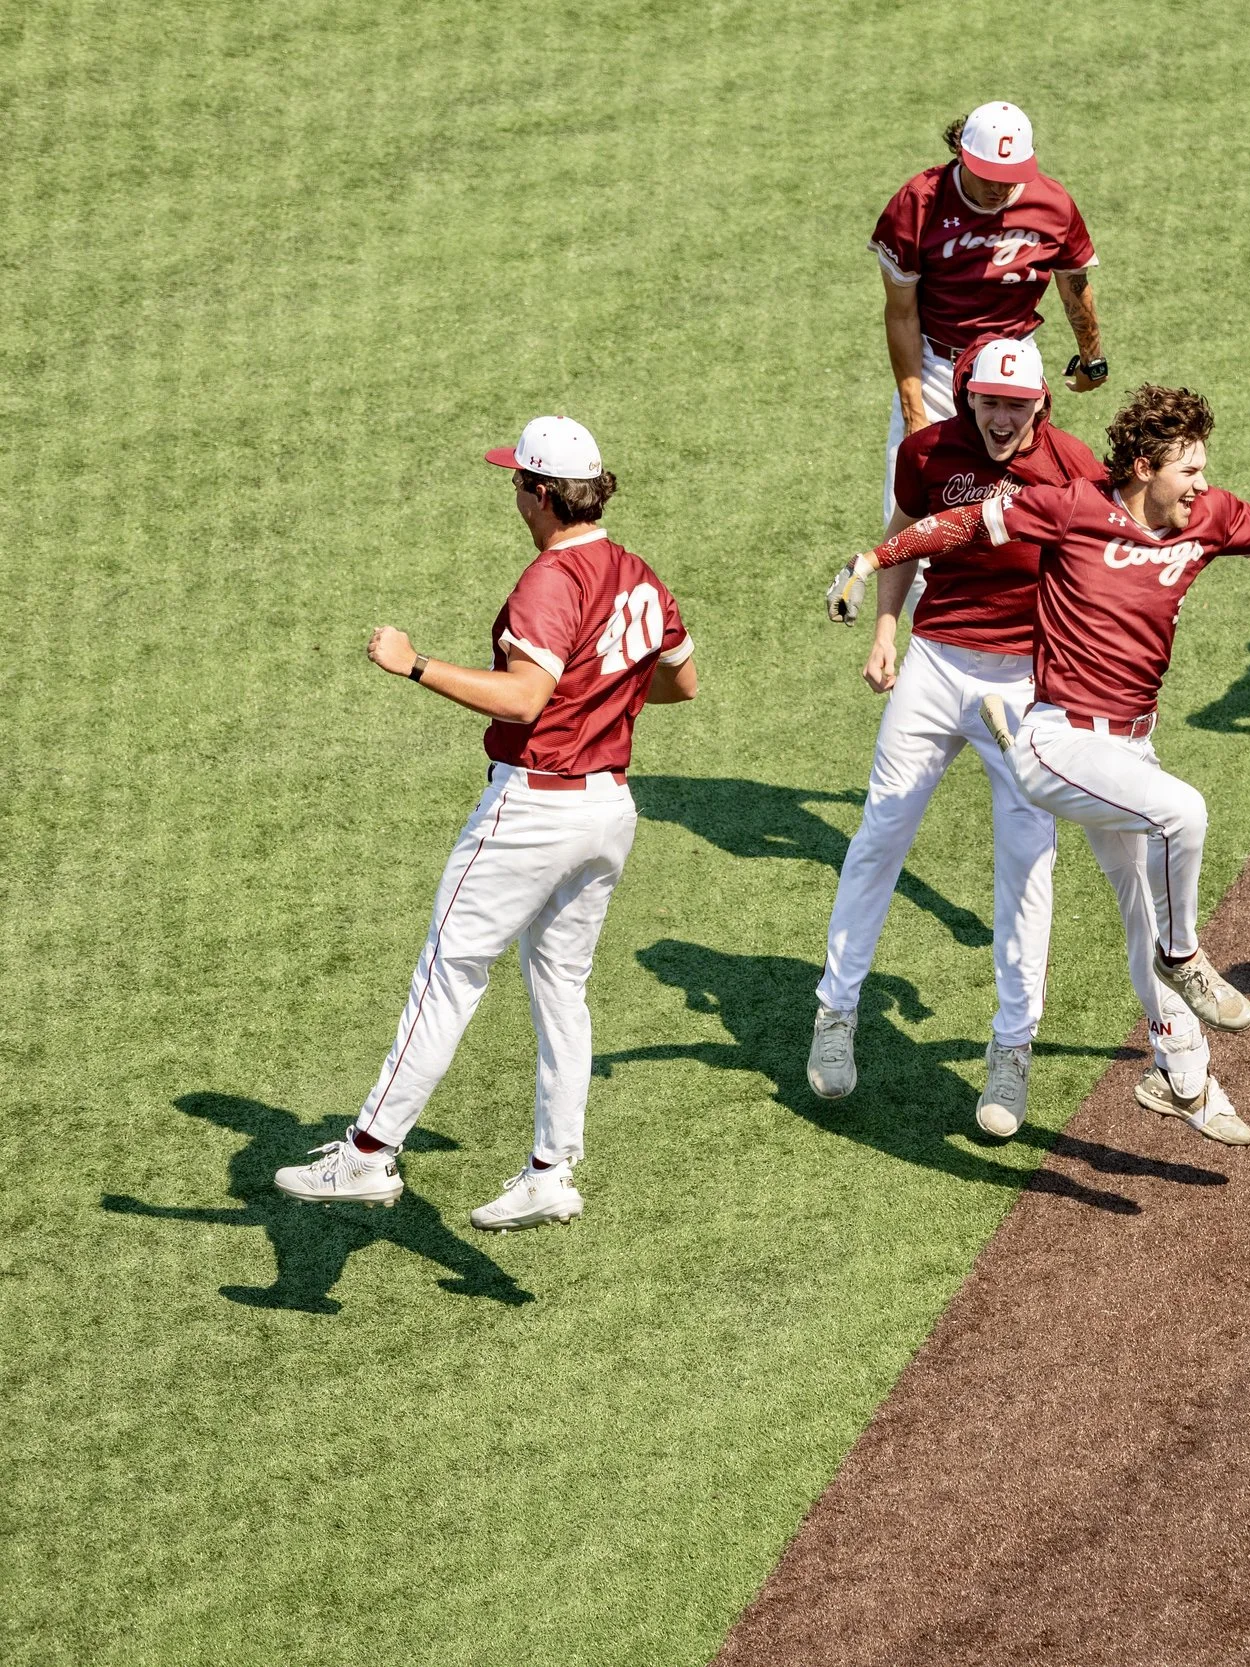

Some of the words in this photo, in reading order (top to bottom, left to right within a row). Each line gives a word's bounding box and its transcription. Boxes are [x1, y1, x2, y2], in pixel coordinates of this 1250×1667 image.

[998, 136, 1014, 158] C
[1000, 353, 1017, 378] C
[1103, 536, 1205, 587] Cougs
[596, 582, 664, 676] 40
